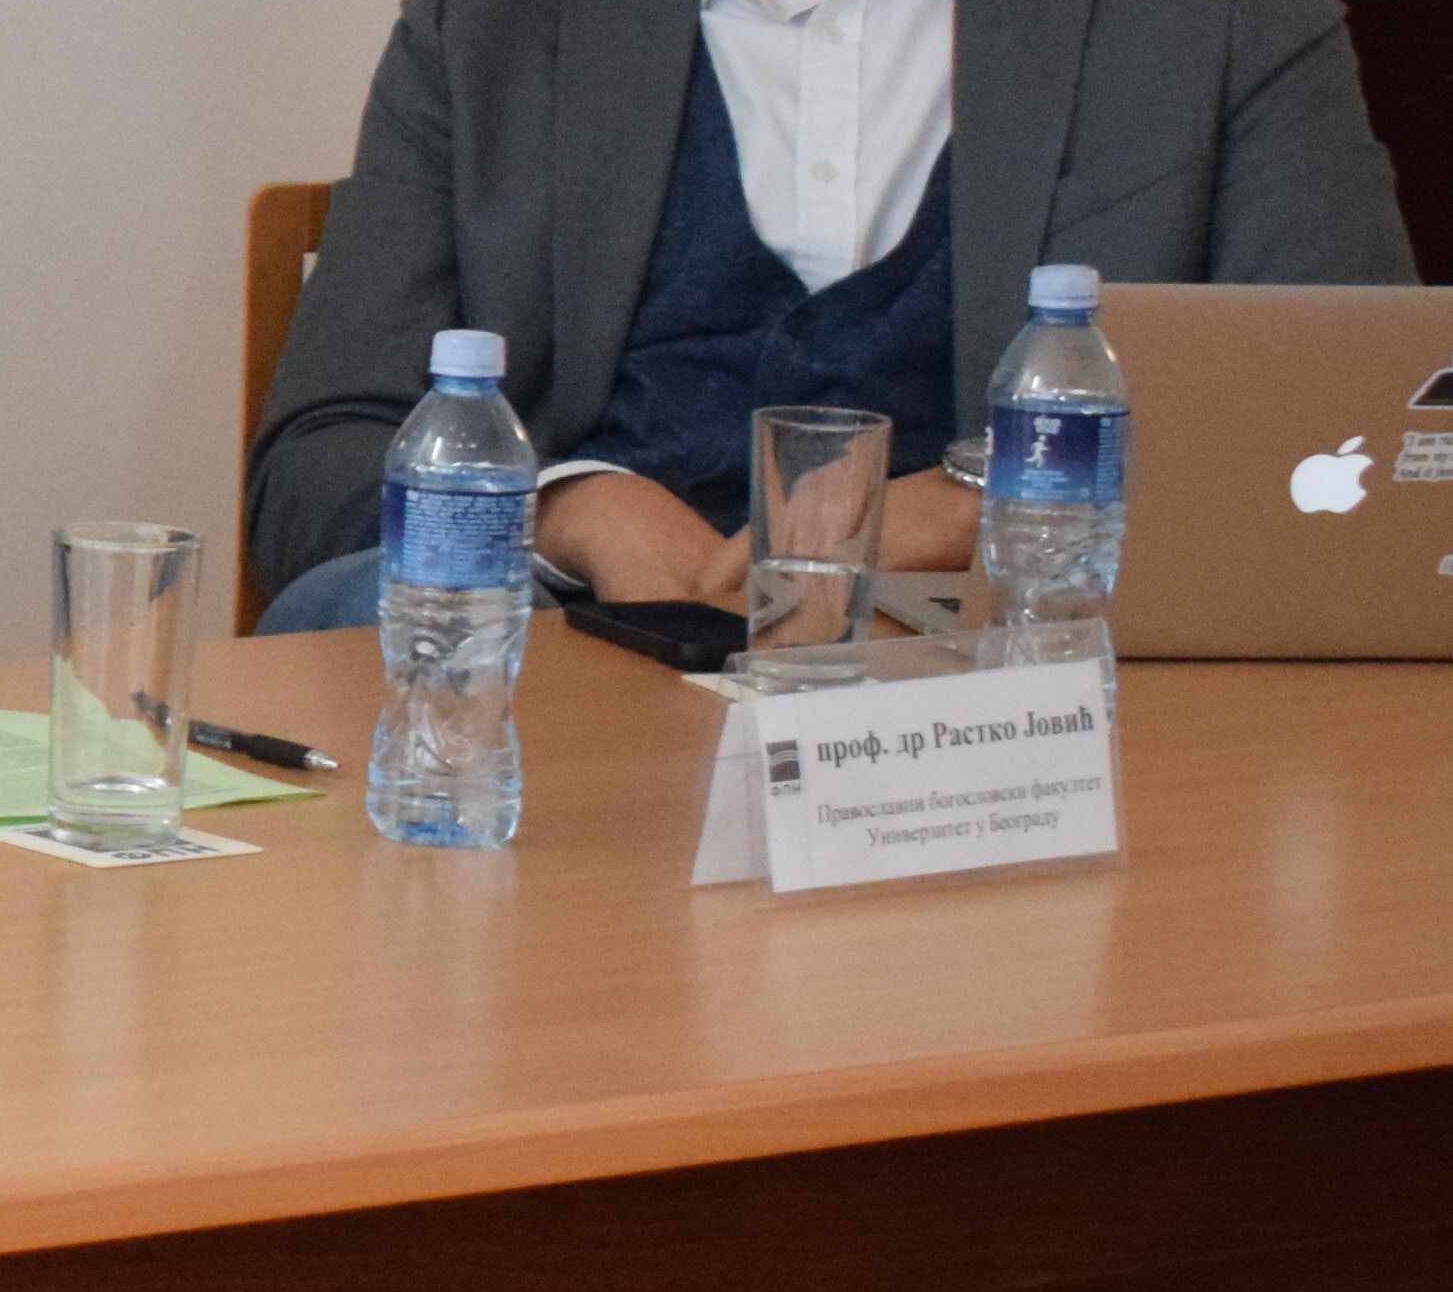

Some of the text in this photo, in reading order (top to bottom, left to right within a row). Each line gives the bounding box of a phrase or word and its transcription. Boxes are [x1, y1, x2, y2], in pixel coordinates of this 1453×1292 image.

[817, 706, 1094, 768] проф. др Растко Јовић
[1030, 777, 1102, 802] факултет
[866, 810, 1059, 846] Универзитет у Београду
